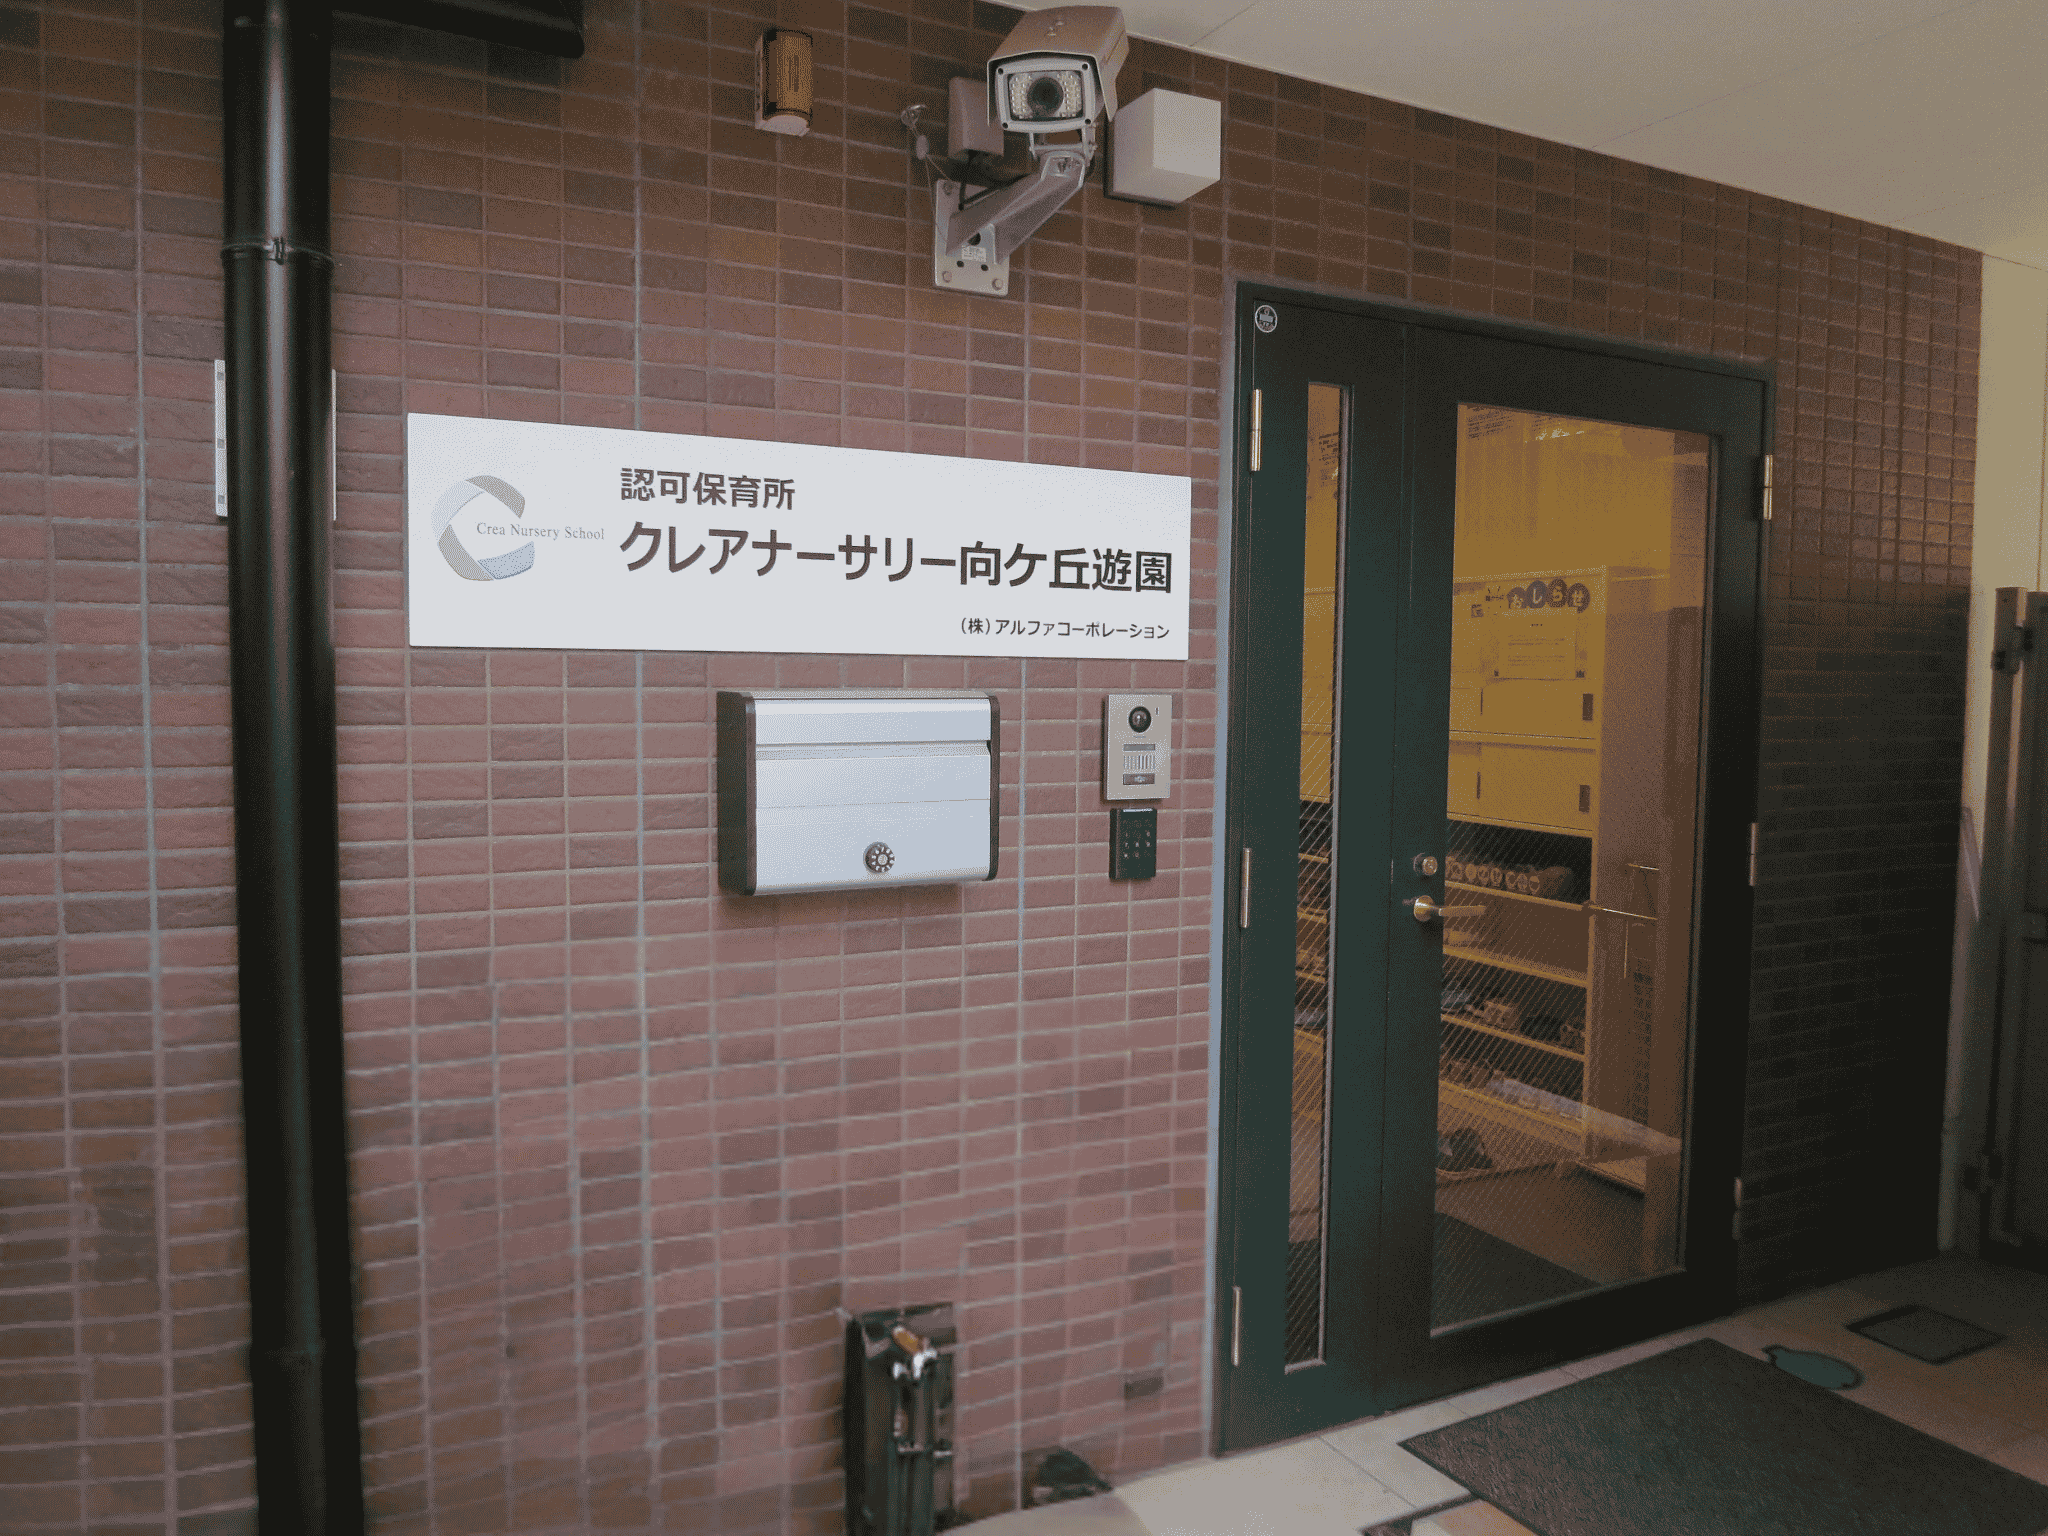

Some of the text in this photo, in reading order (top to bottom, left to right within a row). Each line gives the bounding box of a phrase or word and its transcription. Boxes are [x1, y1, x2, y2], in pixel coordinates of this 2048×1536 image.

[620, 467, 796, 511] 認可保育所
[476, 521, 605, 541] Crea Nursery School
[619, 521, 1172, 593] クレアナーサリー向ケ丘遊園
[1509, 584, 1587, 610] おしらせ
